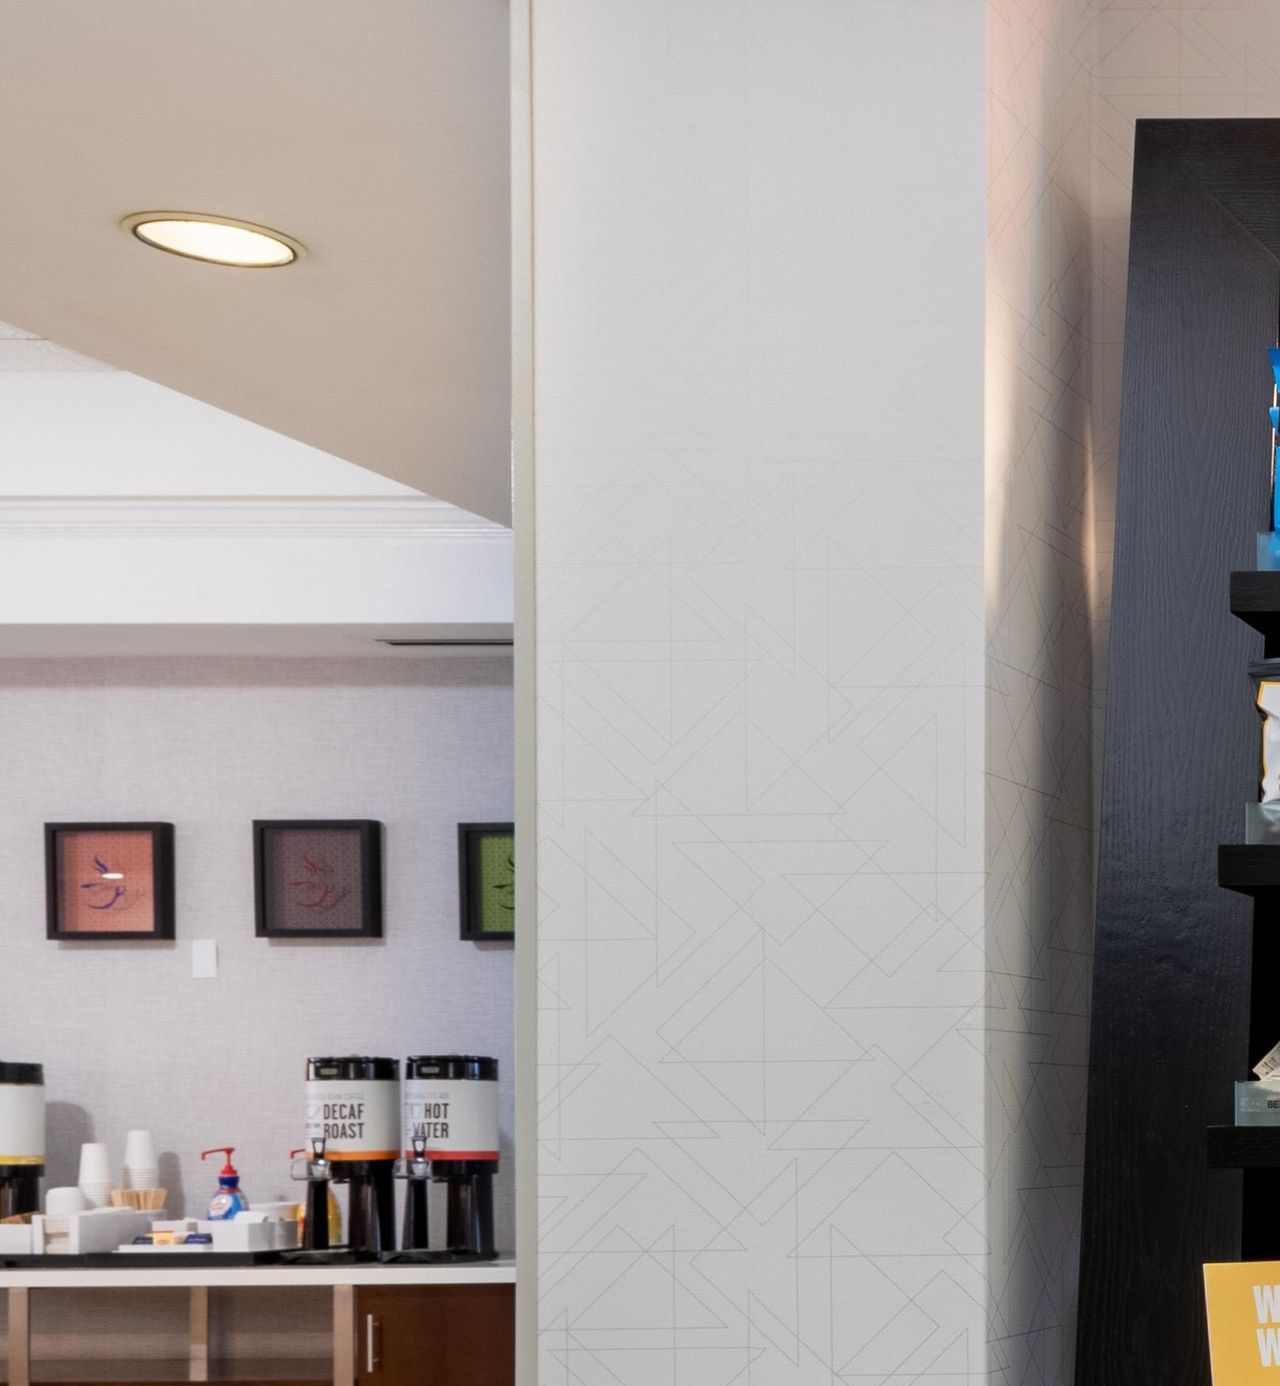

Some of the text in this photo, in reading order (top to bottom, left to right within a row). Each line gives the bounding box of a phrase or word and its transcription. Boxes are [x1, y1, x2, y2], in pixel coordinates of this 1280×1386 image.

[323, 1103, 365, 1120] DECAF
[424, 1103, 449, 1119] HOT
[323, 1123, 365, 1139] ROAST
